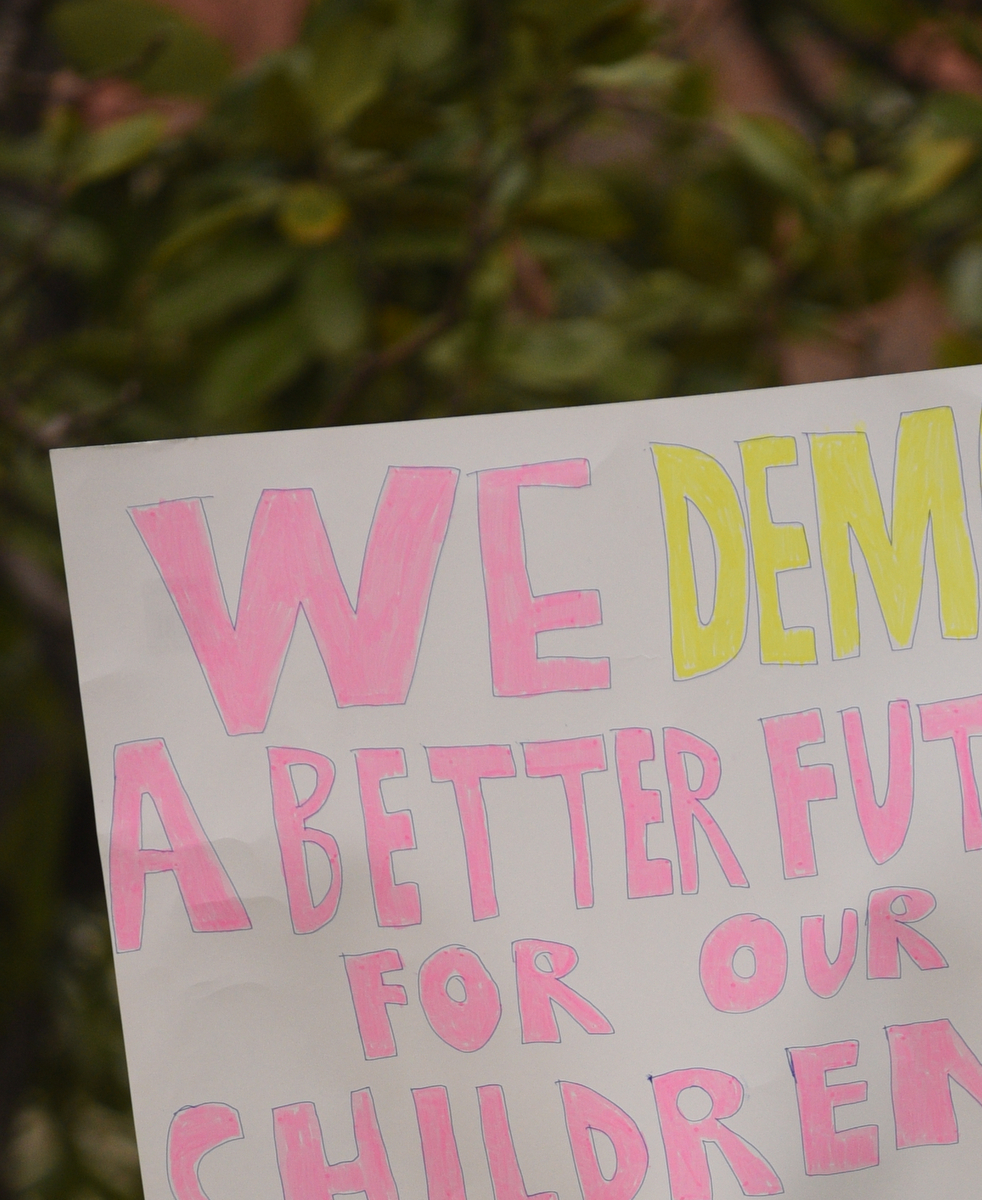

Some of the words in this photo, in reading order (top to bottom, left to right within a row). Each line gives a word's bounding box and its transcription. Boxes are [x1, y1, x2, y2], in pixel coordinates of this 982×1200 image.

[127, 458, 611, 736] WE
[109, 738, 252, 953] A
[266, 727, 750, 935] BETTER
[340, 938, 615, 1060] FOR
[699, 886, 948, 1013] OUR
